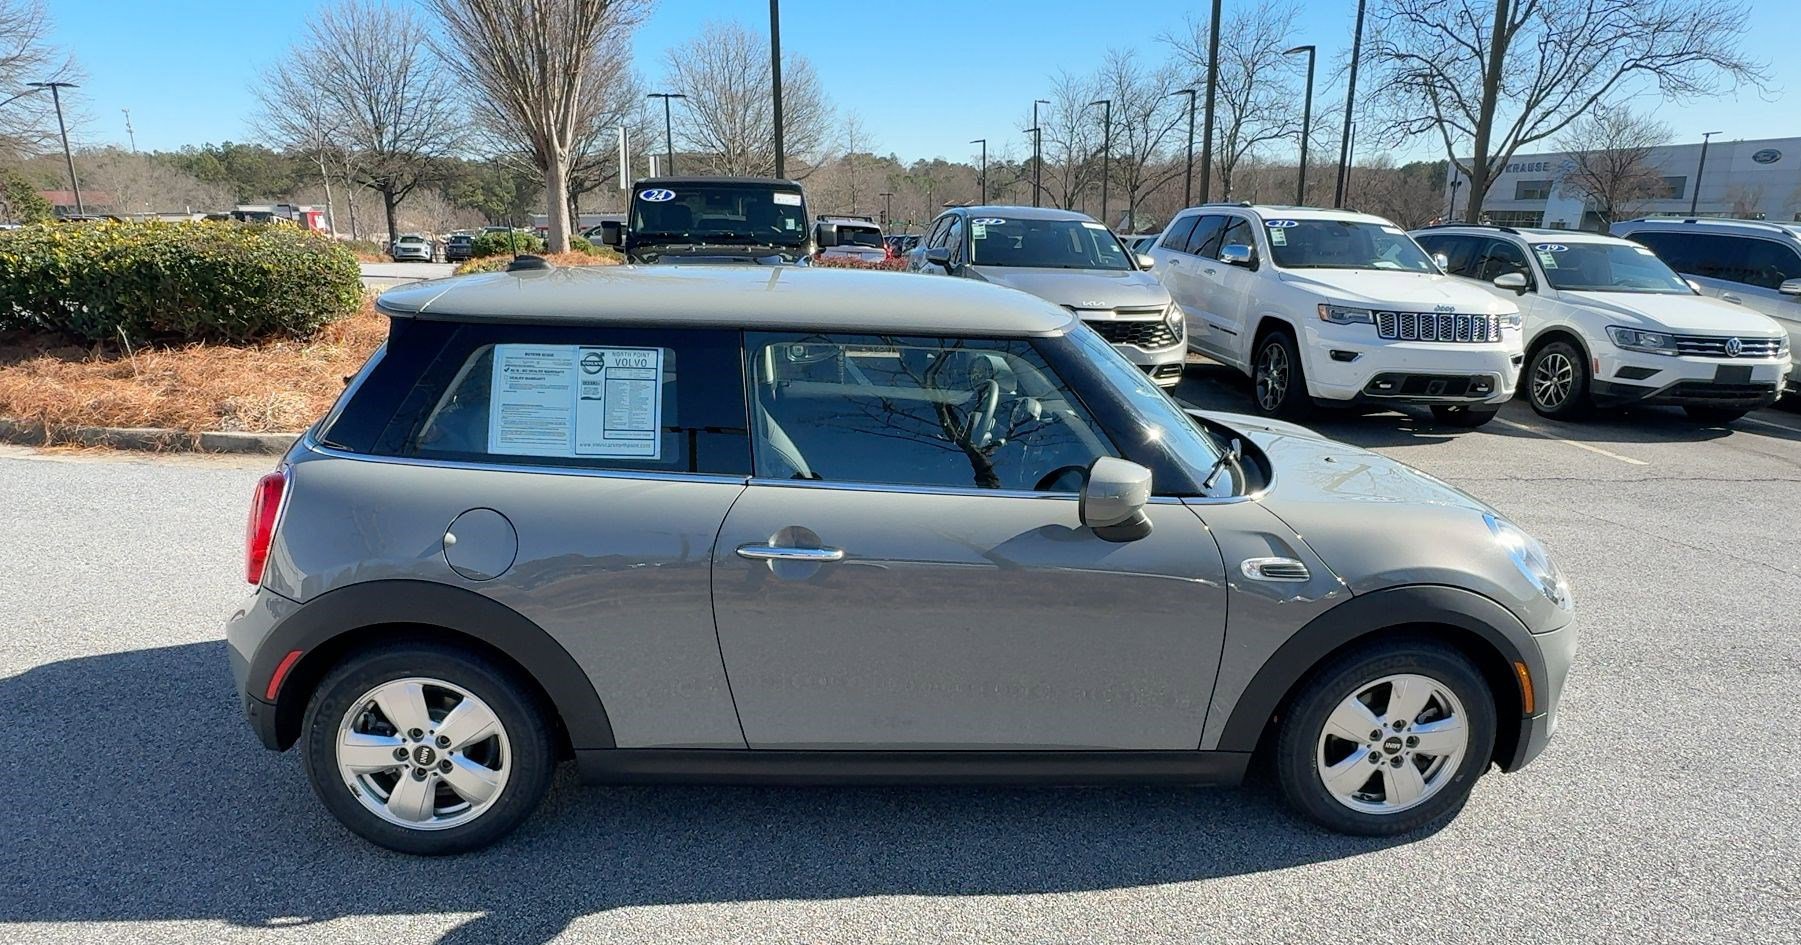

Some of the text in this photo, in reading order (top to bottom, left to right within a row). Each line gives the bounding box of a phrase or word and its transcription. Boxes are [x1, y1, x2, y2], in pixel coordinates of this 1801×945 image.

[1505, 162, 1551, 173] KRAUSE
[1433, 304, 1455, 312] Jeep
[615, 358, 648, 368] VOLVO
[420, 747, 429, 763] MINI
